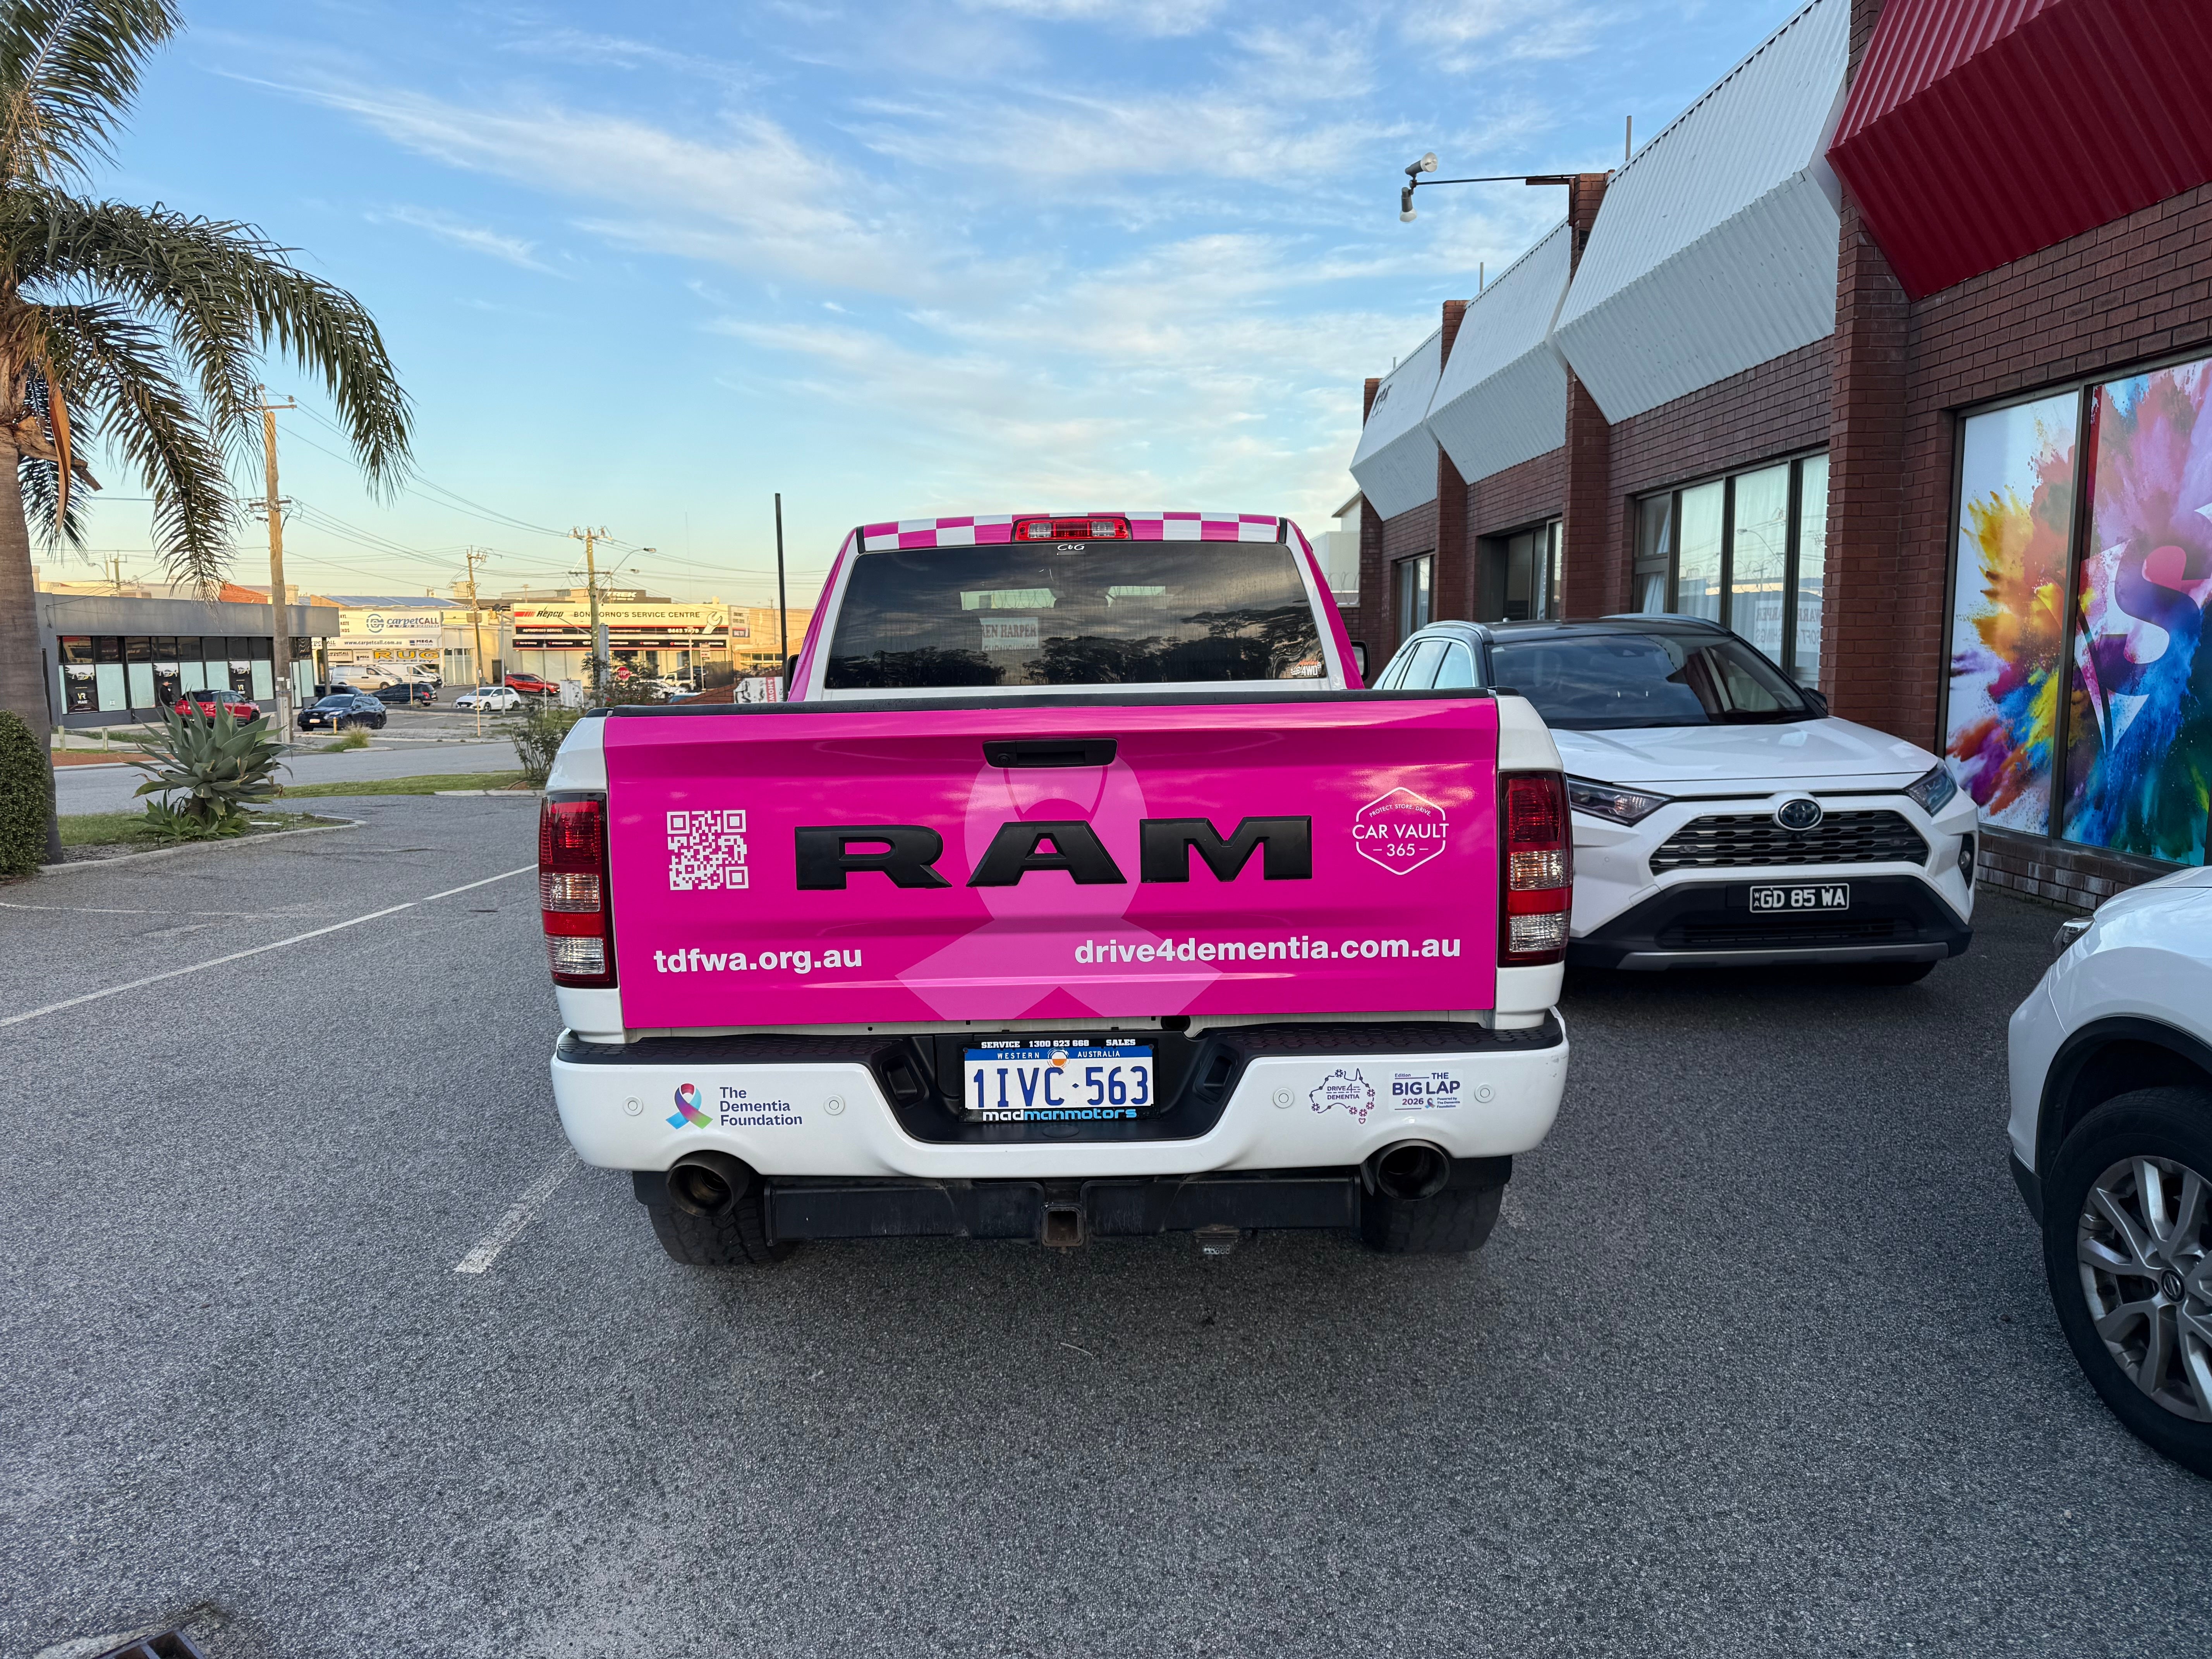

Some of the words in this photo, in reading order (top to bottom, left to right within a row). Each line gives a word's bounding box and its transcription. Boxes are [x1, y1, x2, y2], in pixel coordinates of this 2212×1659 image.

[386, 617, 439, 627] carpetCALL
[1000, 623, 1037, 638] HARPER
[374, 651, 440, 659] RUG
[1352, 824, 1389, 839] CAR
[1394, 823, 1449, 839] VAULT
[795, 816, 1313, 890] RAM
[1386, 843, 1415, 857] 365
[1760, 890, 1785, 908] GD
[1791, 889, 1815, 907] 85
[1821, 888, 1846, 906] WA
[1074, 936, 1461, 963] drive4dementia.com.au
[653, 948, 862, 974] tdfwa.org.au
[1077, 1050, 1120, 1058] AUSTRALIA
[719, 1086, 747, 1099] The
[1392, 1082, 1422, 1096] BIG
[1426, 1080, 1460, 1095] LAP
[720, 1099, 791, 1112] Dementia
[1402, 1097, 1424, 1106] 2026
[721, 1113, 803, 1126] Foundation
[982, 1108, 1137, 1121] madmanmotors
